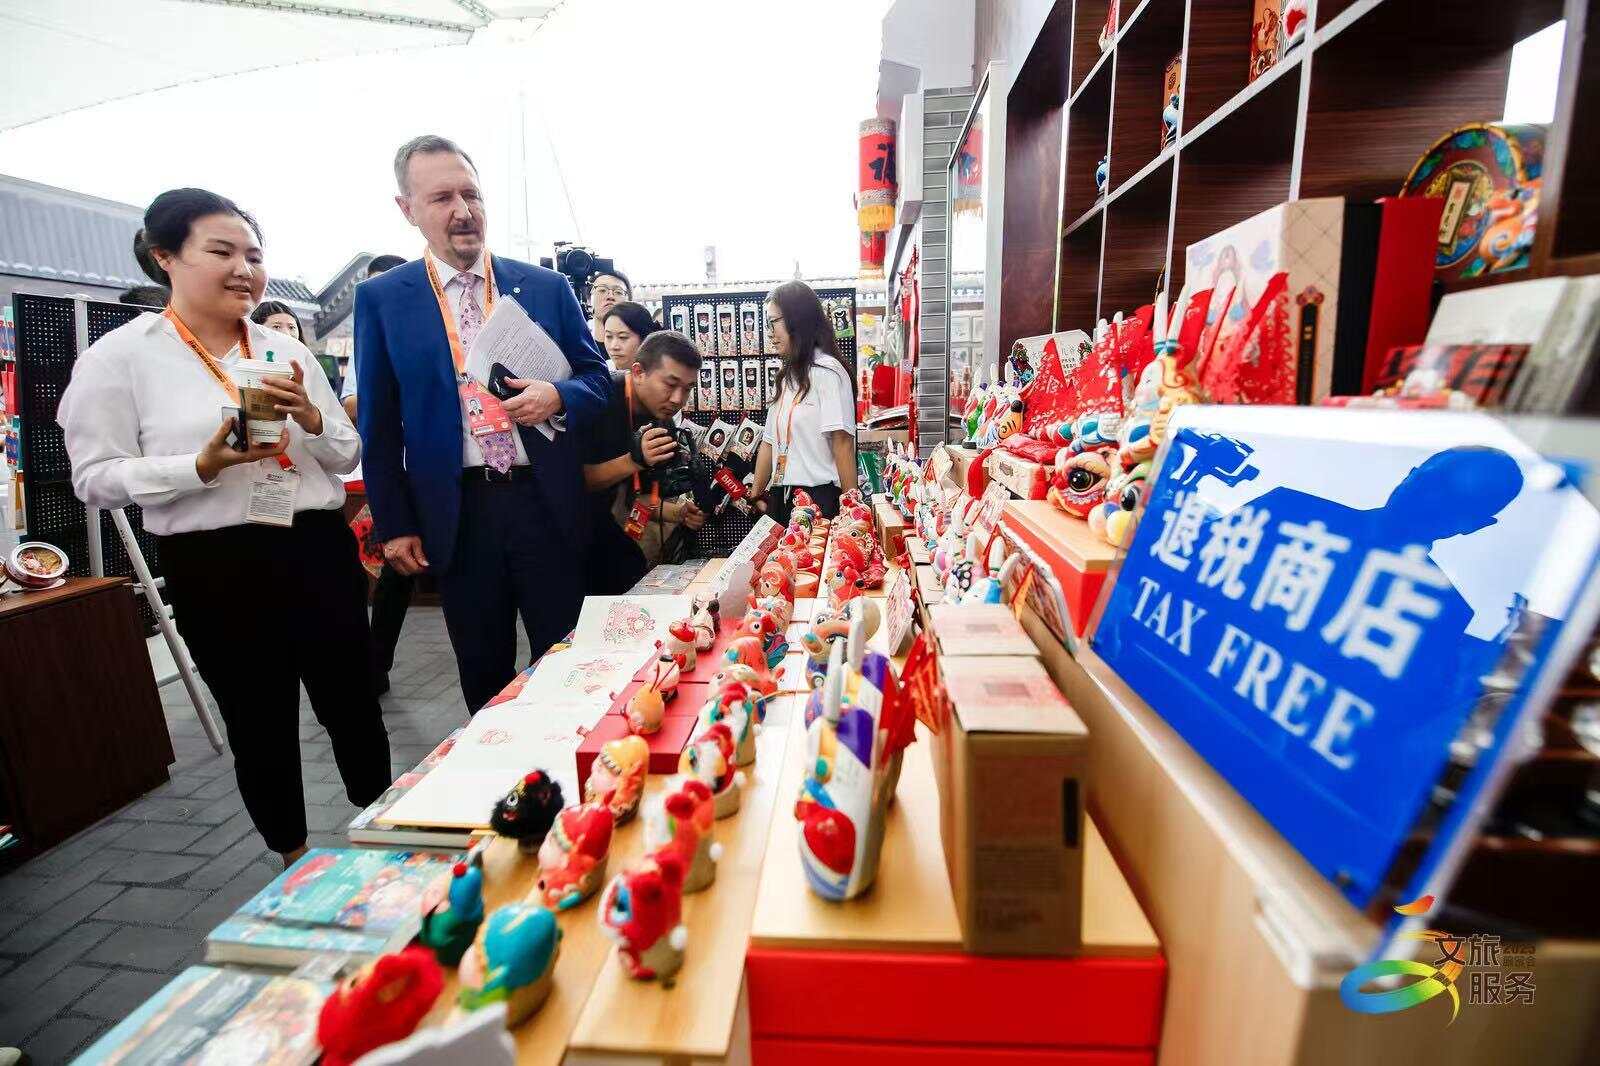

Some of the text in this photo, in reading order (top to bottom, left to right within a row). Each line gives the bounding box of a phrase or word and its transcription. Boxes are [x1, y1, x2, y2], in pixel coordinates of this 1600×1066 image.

[1131, 576, 1376, 770] TAX FREE
[1150, 488, 1452, 680] 退税商店
